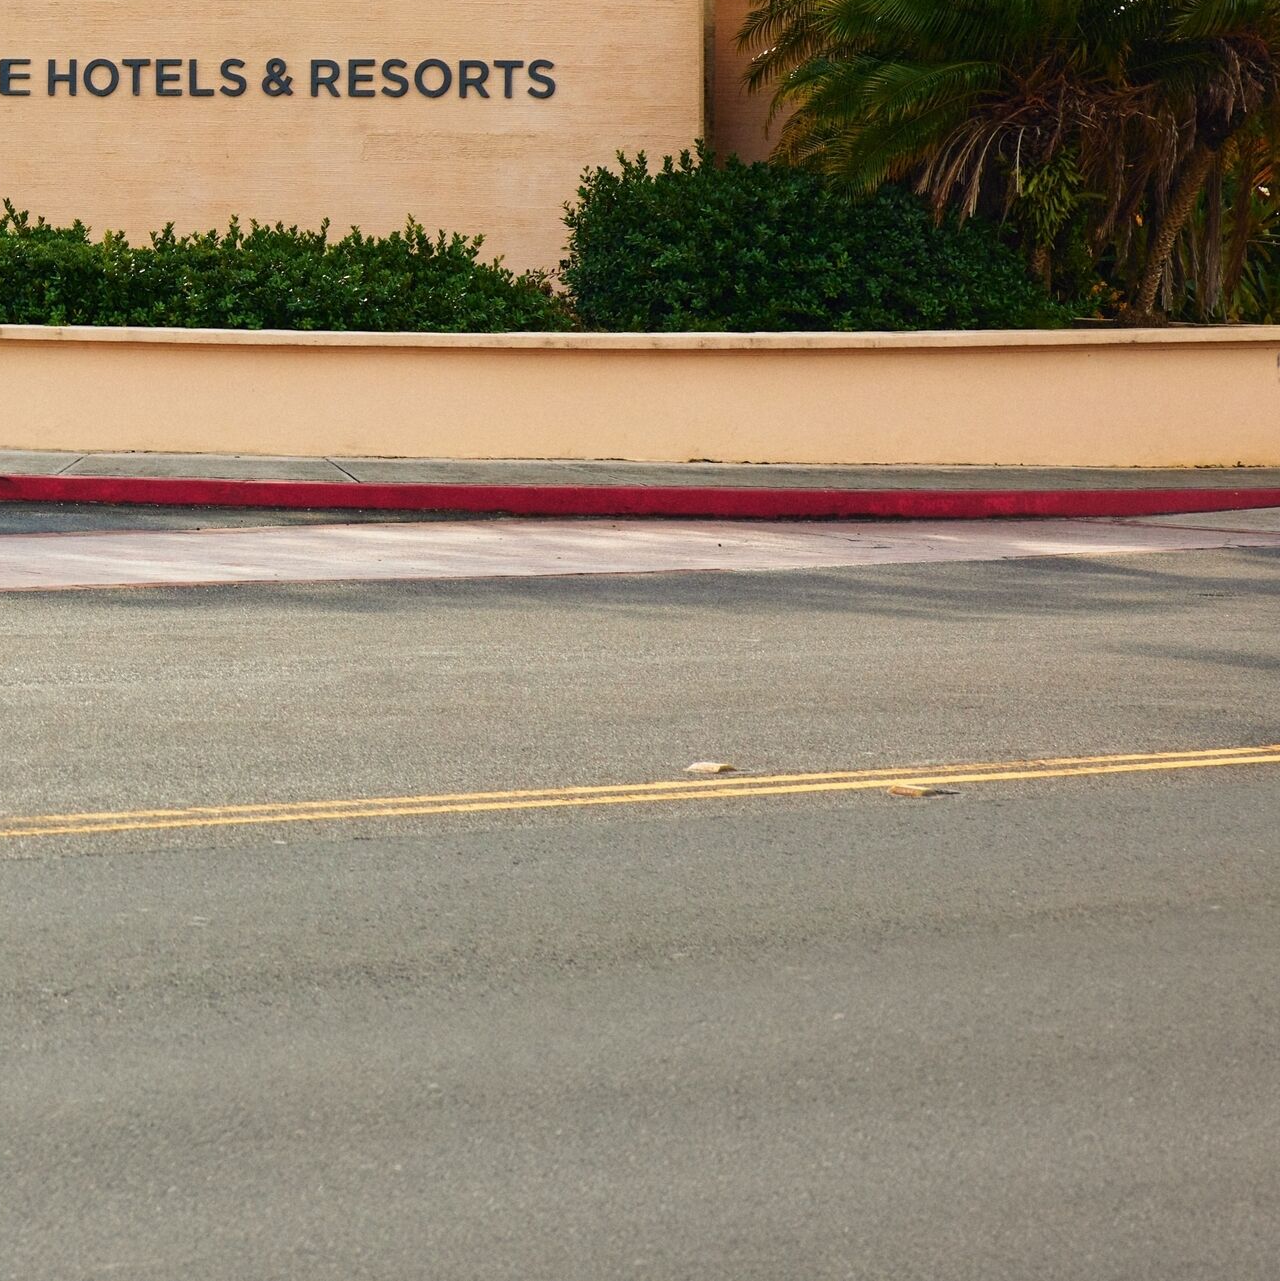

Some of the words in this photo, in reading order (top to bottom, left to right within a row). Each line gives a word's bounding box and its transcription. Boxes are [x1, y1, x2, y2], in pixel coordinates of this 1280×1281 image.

[47, 57, 248, 98] HOTELS
[261, 57, 294, 98] &
[310, 58, 557, 100] RESORTS
